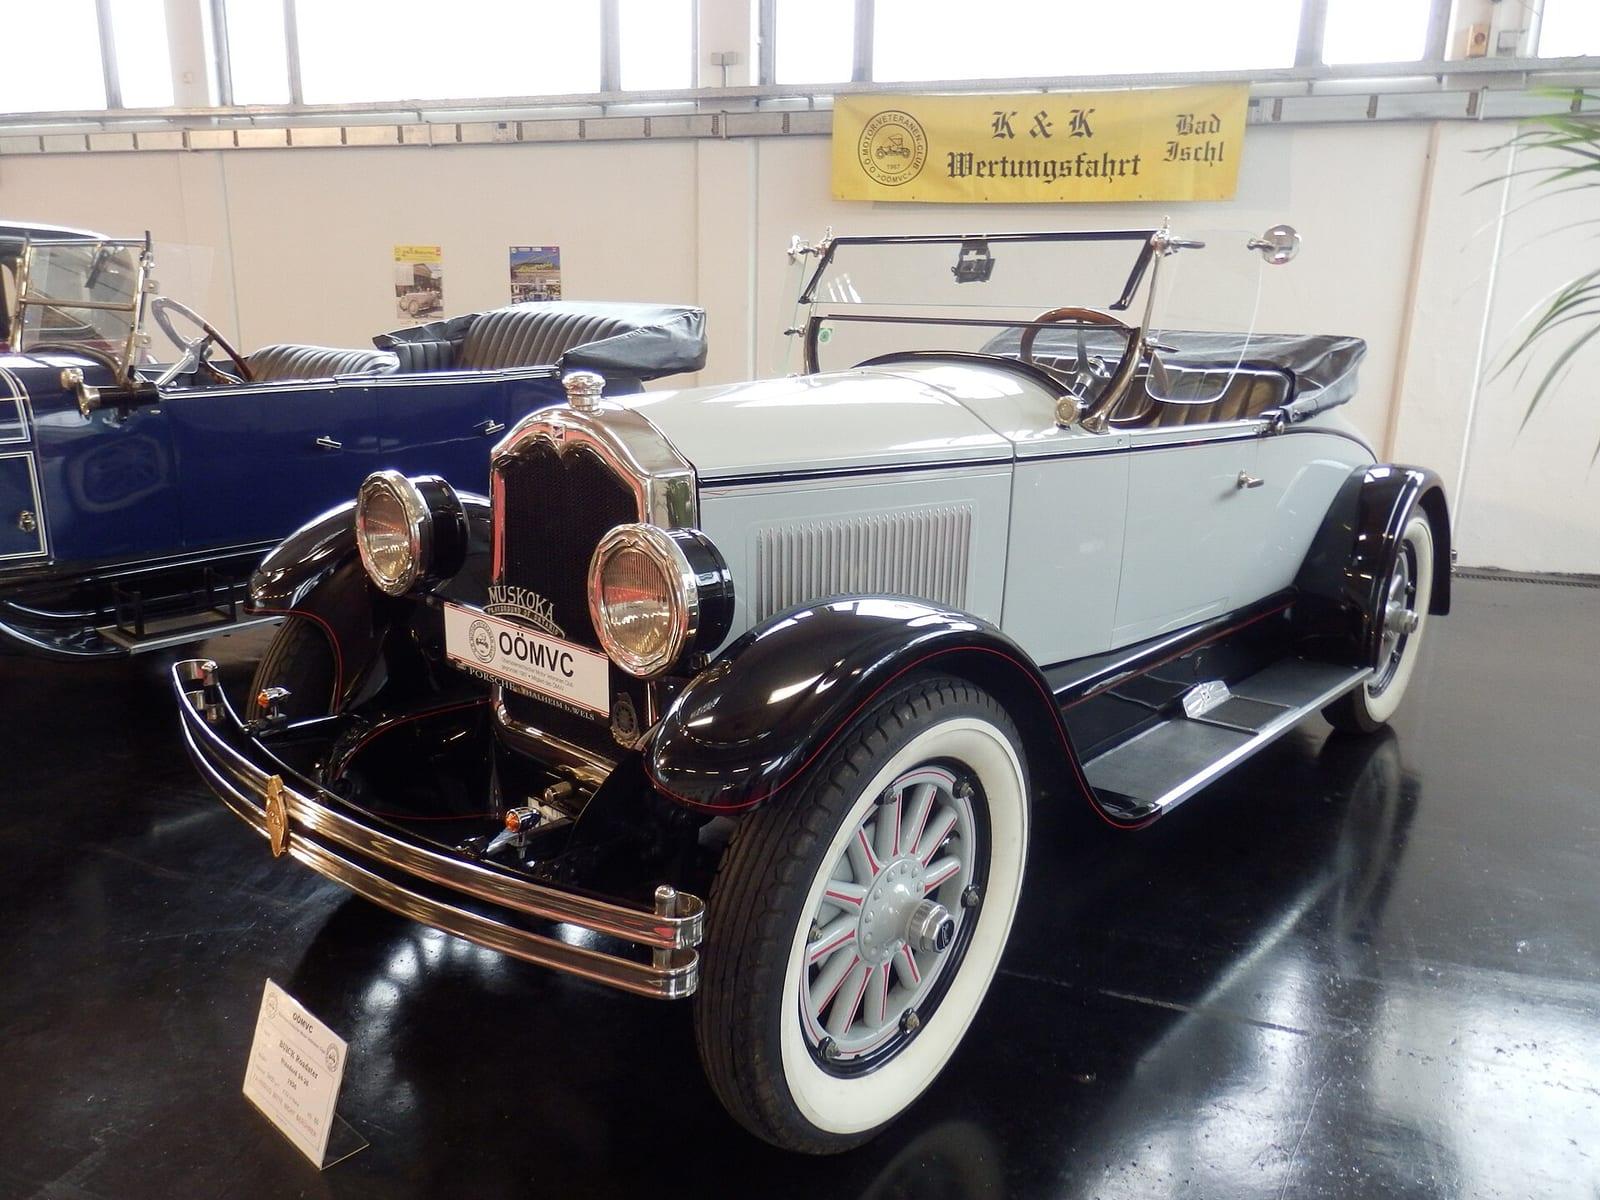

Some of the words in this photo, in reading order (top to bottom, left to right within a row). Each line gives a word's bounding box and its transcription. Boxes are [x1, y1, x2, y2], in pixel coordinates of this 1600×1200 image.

[992, 111, 1017, 139] K
[1029, 110, 1053, 138] &
[1069, 108, 1096, 138] K
[1176, 113, 1221, 136] Bad
[947, 151, 1141, 184] Wertungsfahrt
[1163, 141, 1224, 167] Ischl
[488, 585, 554, 621] MUSKOKA
[499, 631, 574, 677] OÖMVC
